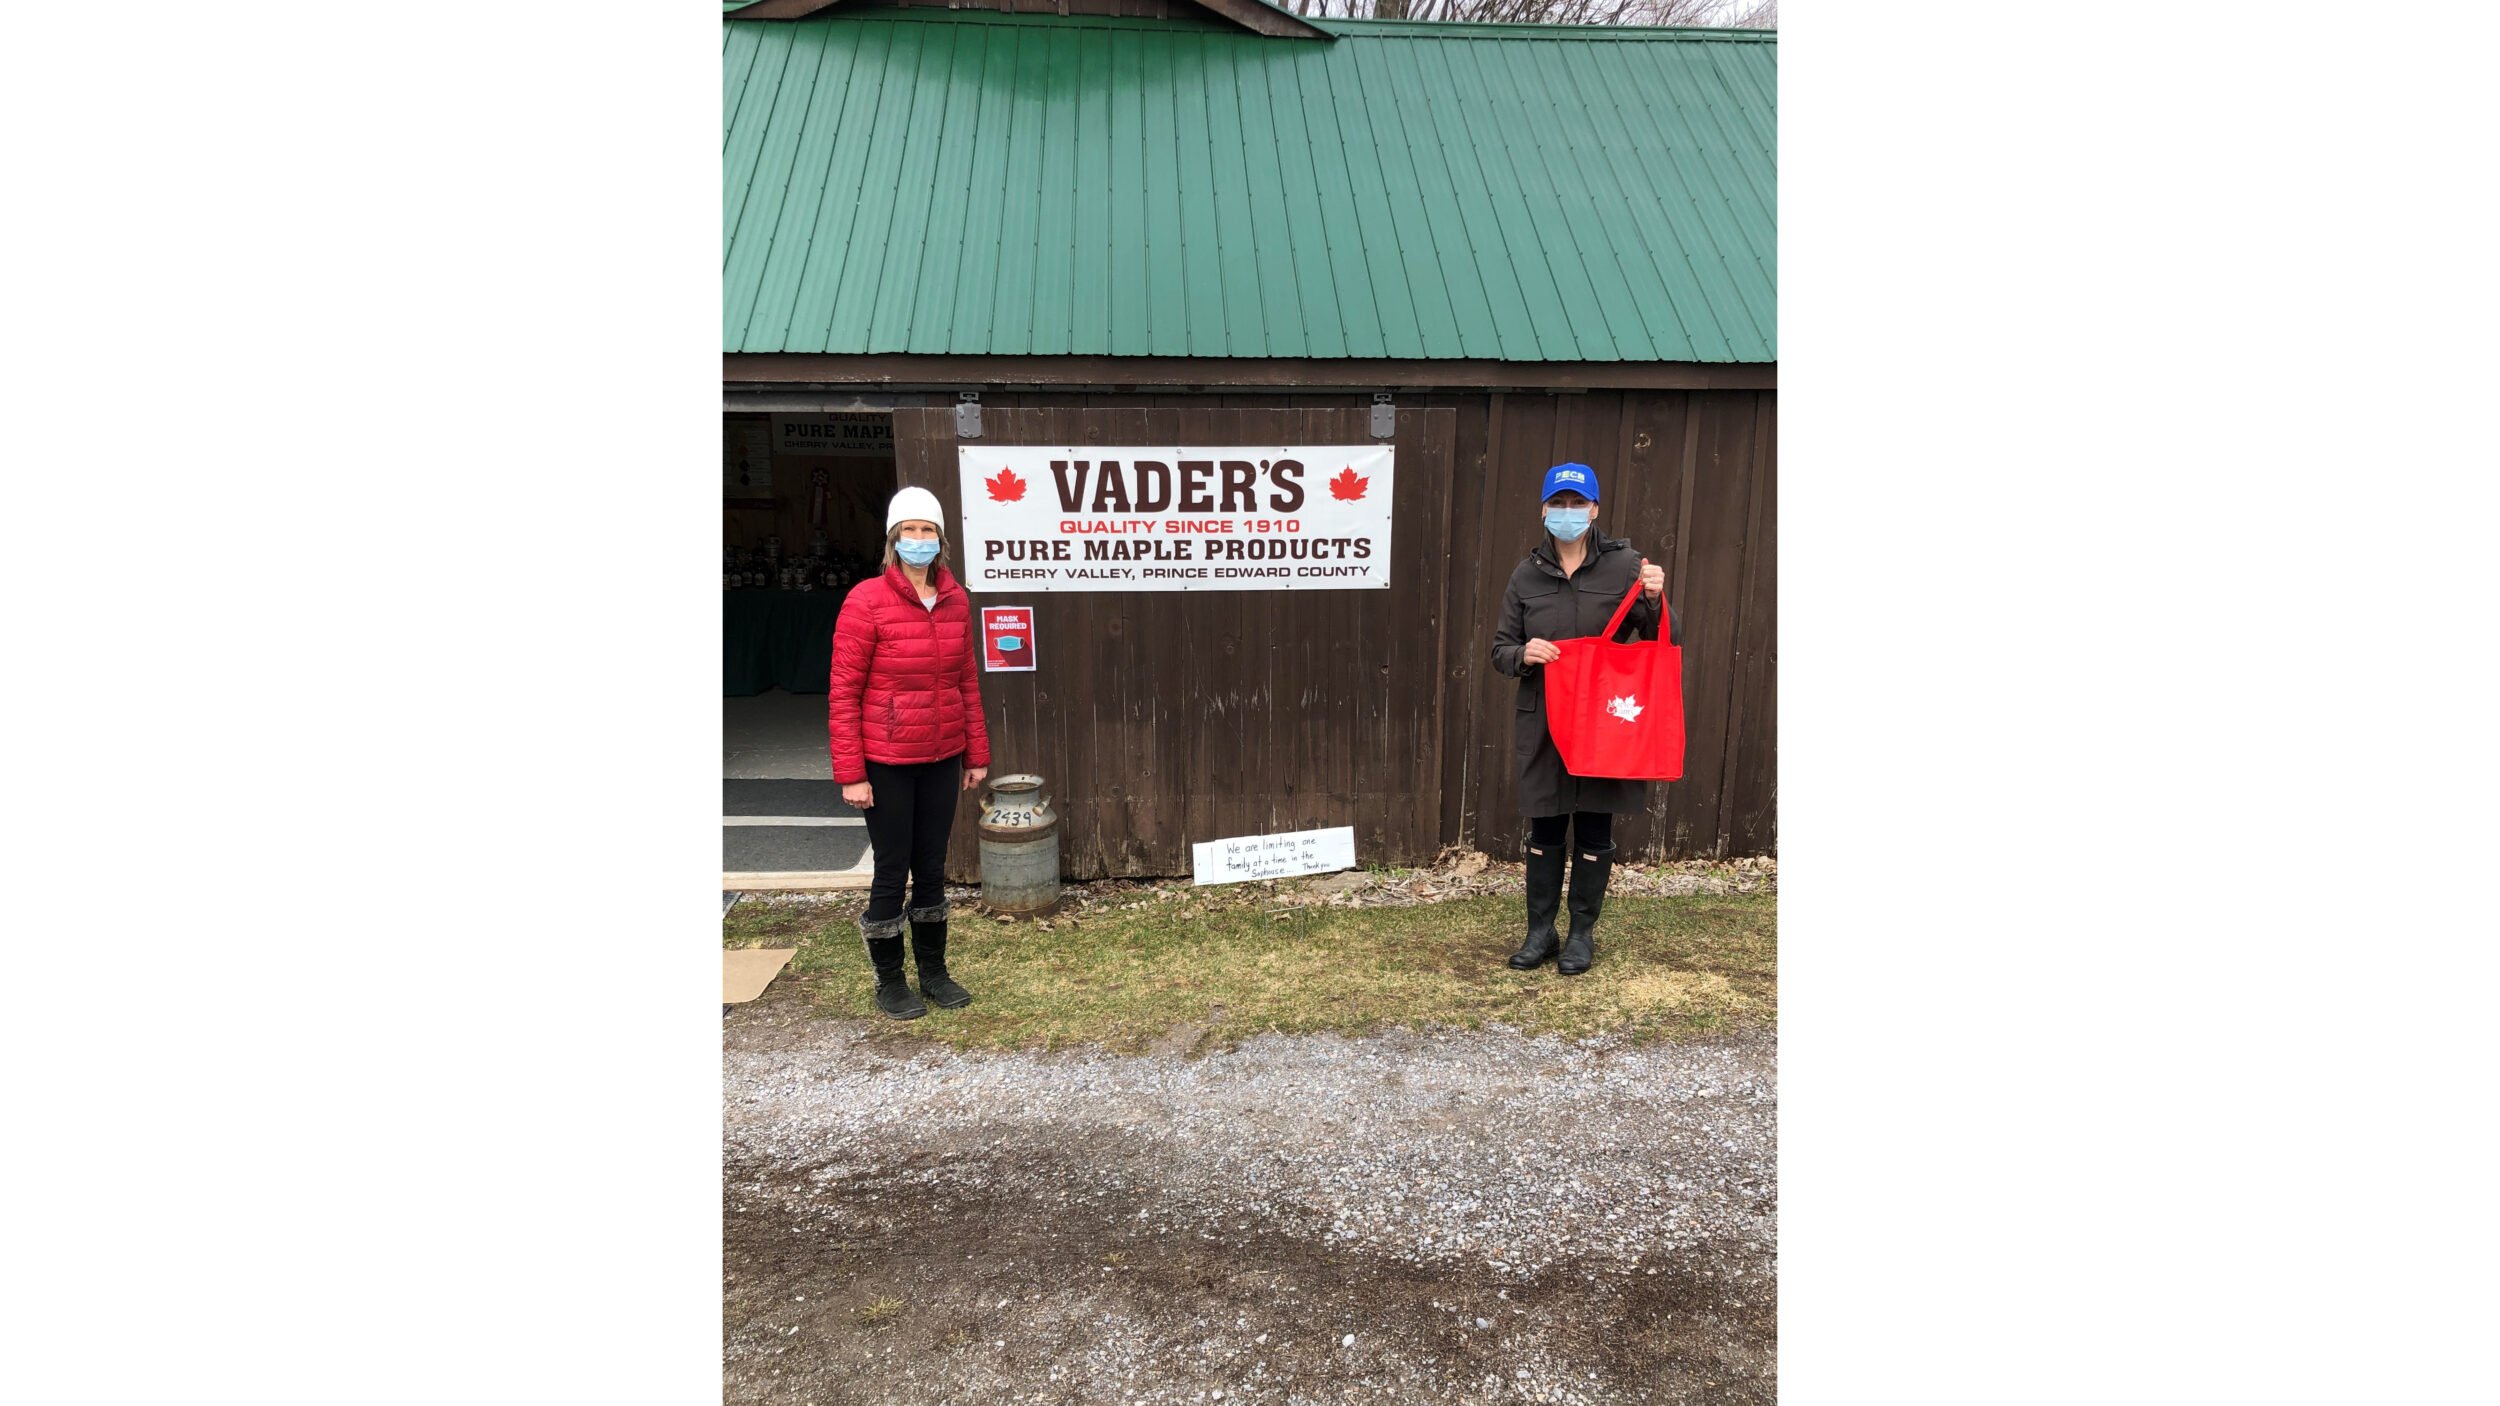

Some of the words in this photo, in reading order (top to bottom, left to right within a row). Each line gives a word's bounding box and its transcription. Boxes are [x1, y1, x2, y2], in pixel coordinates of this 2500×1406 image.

[829, 413, 886, 422] QUALITY
[784, 424, 836, 438] PURE
[843, 425, 894, 439] MAPL
[784, 440, 828, 449] CHERRY
[1060, 521, 1157, 533] QUALITY
[1165, 520, 1234, 533] SINCE
[1243, 520, 1300, 533] 1910
[985, 540, 1071, 561] PURE
[1084, 540, 1192, 561] MAPLE
[1205, 538, 1371, 560] PRODUCTS
[984, 568, 1058, 579] CHERRY
[1065, 568, 1135, 581] VALLEY,
[1143, 568, 1208, 579] PRINCE
[1214, 567, 1291, 578] EDWARD
[1297, 566, 1370, 577] COUNTY
[1227, 843, 1240, 854] We
[1245, 844, 1258, 852] are
[1263, 837, 1295, 852] limiting
[1302, 838, 1316, 846] one
[1226, 857, 1250, 872] family
[1253, 855, 1262, 866] at
[1272, 853, 1287, 864] time
[1301, 851, 1314, 860] the
